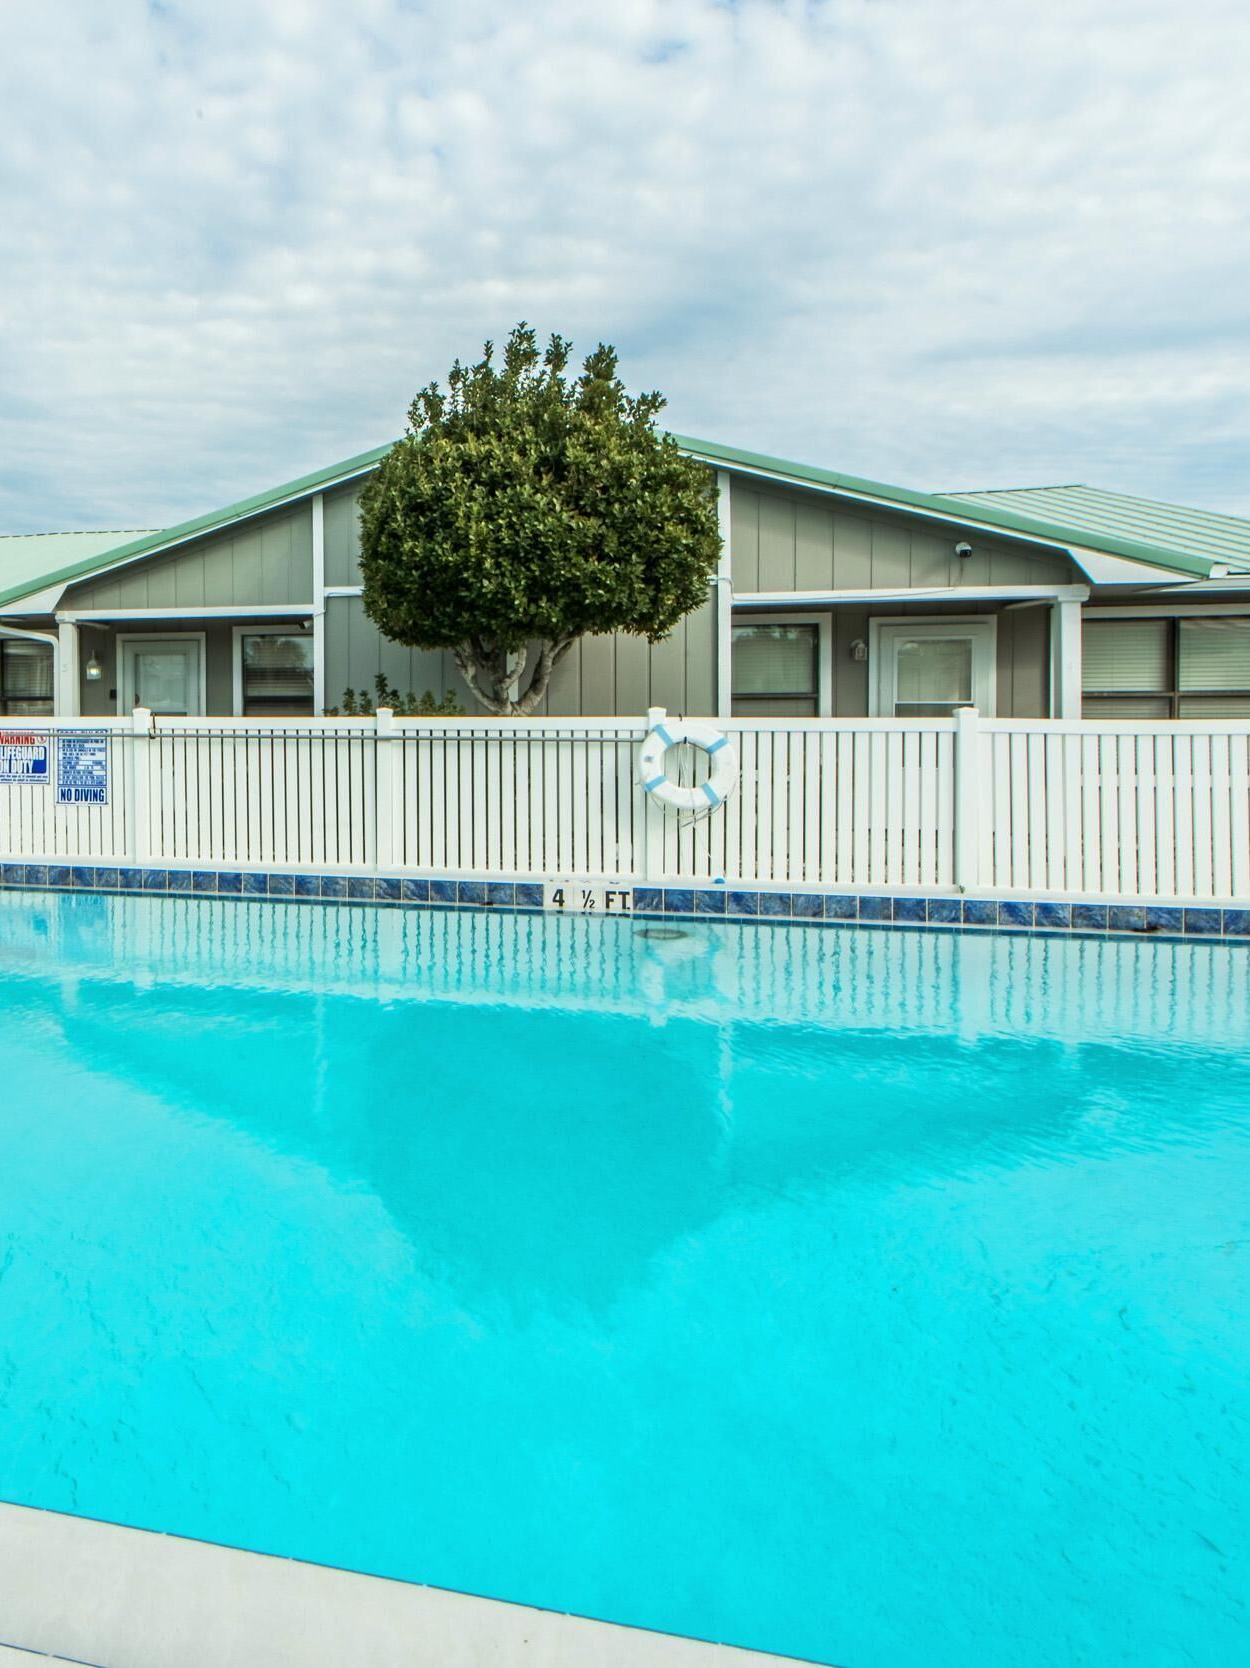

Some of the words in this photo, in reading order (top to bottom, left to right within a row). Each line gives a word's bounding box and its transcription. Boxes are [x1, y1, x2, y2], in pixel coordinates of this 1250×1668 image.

[0, 746, 45, 760] LIFEGUARD
[11, 760, 34, 774] DUTY
[60, 788, 72, 802] NO
[74, 788, 105, 802] DIVING
[552, 889, 565, 907] 4
